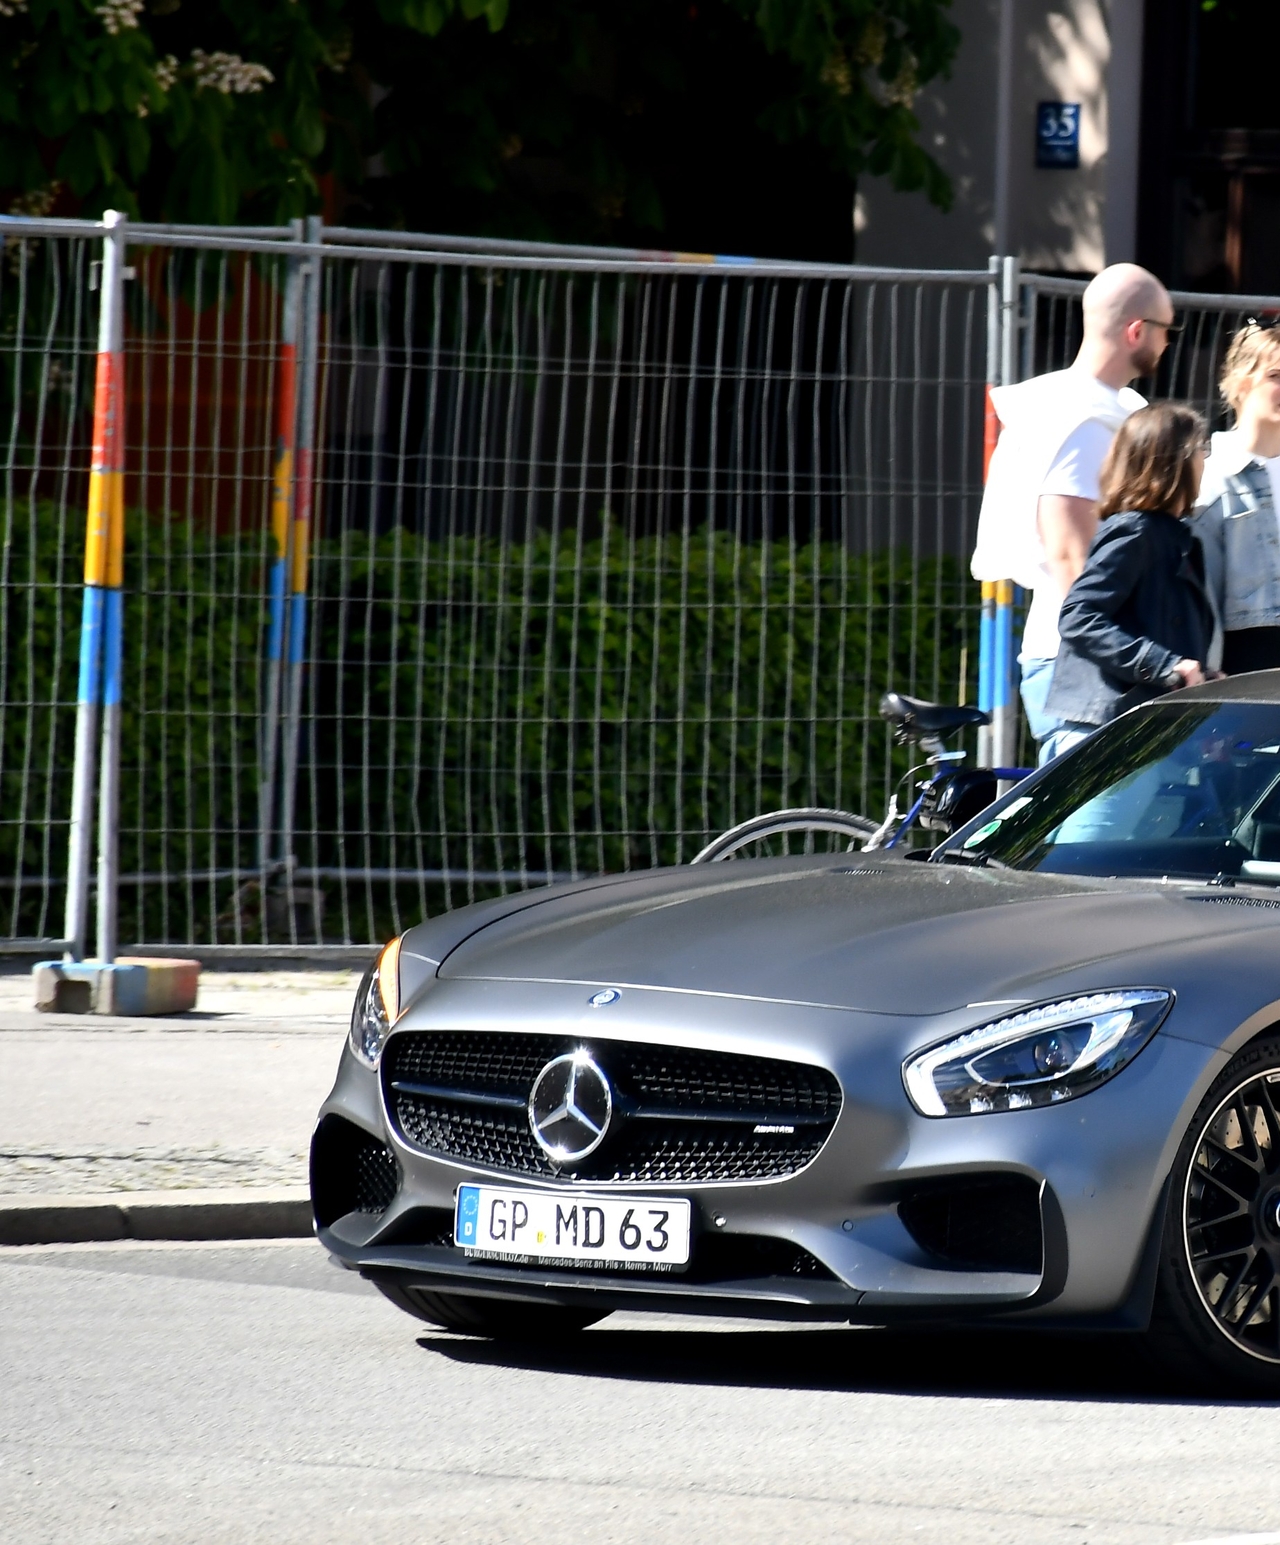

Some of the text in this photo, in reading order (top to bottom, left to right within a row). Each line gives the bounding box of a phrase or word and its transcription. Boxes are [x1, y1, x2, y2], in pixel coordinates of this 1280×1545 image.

[1042, 107, 1076, 138] 35
[464, 1221, 472, 1237] D
[489, 1199, 669, 1252] GP MD 63
[653, 1262, 673, 1272] Murr
